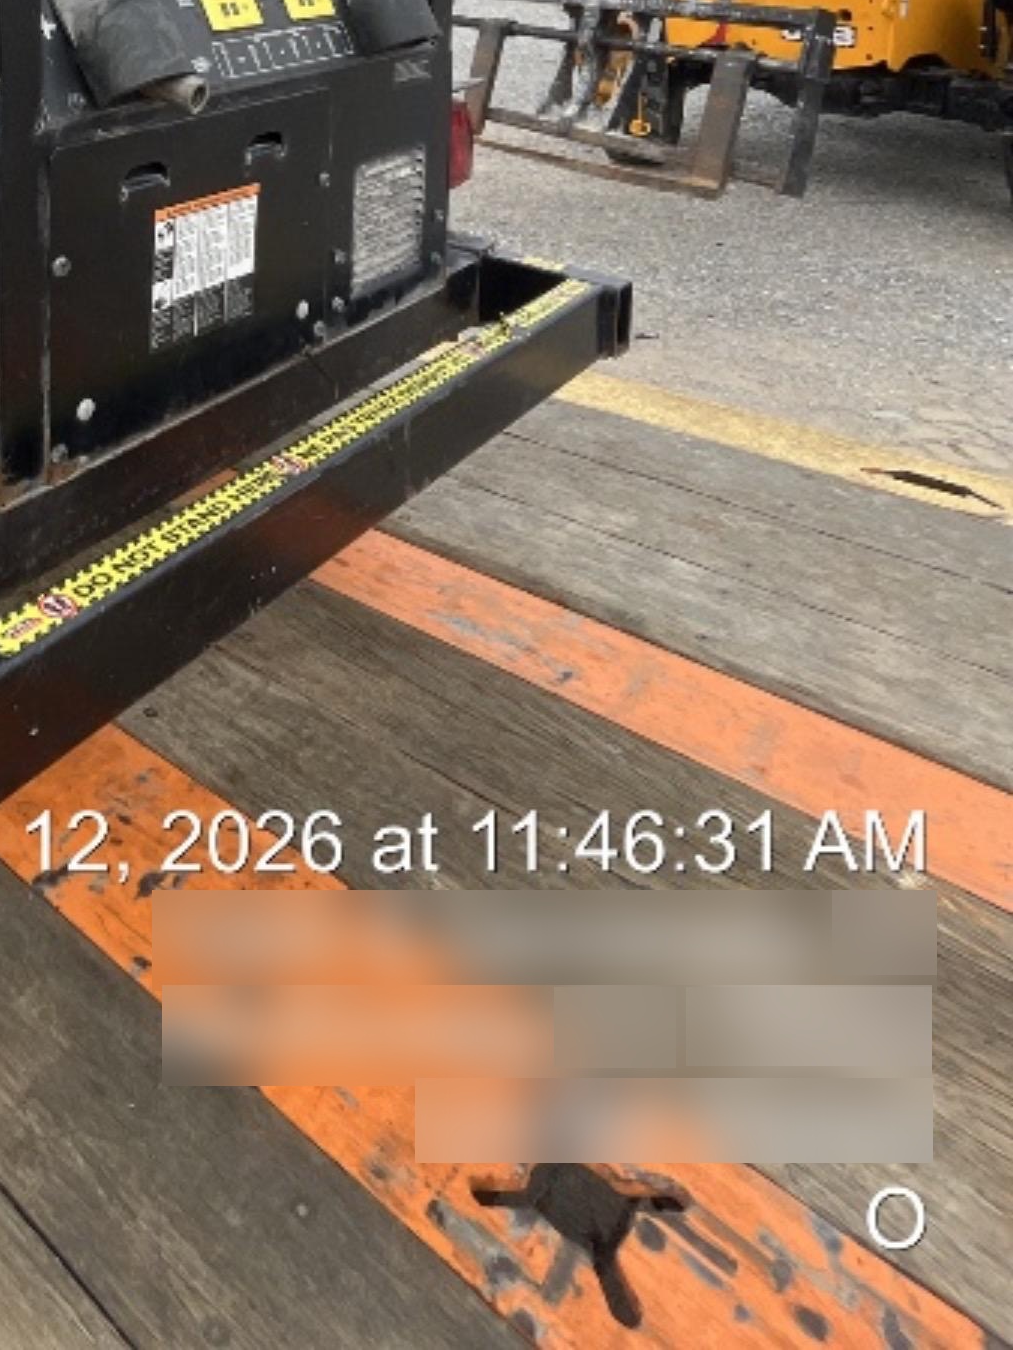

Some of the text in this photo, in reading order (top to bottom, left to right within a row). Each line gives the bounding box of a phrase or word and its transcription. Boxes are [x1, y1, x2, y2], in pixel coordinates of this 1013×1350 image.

[73, 572, 112, 598] DO
[112, 538, 156, 575] NOT
[160, 498, 231, 545] STAND
